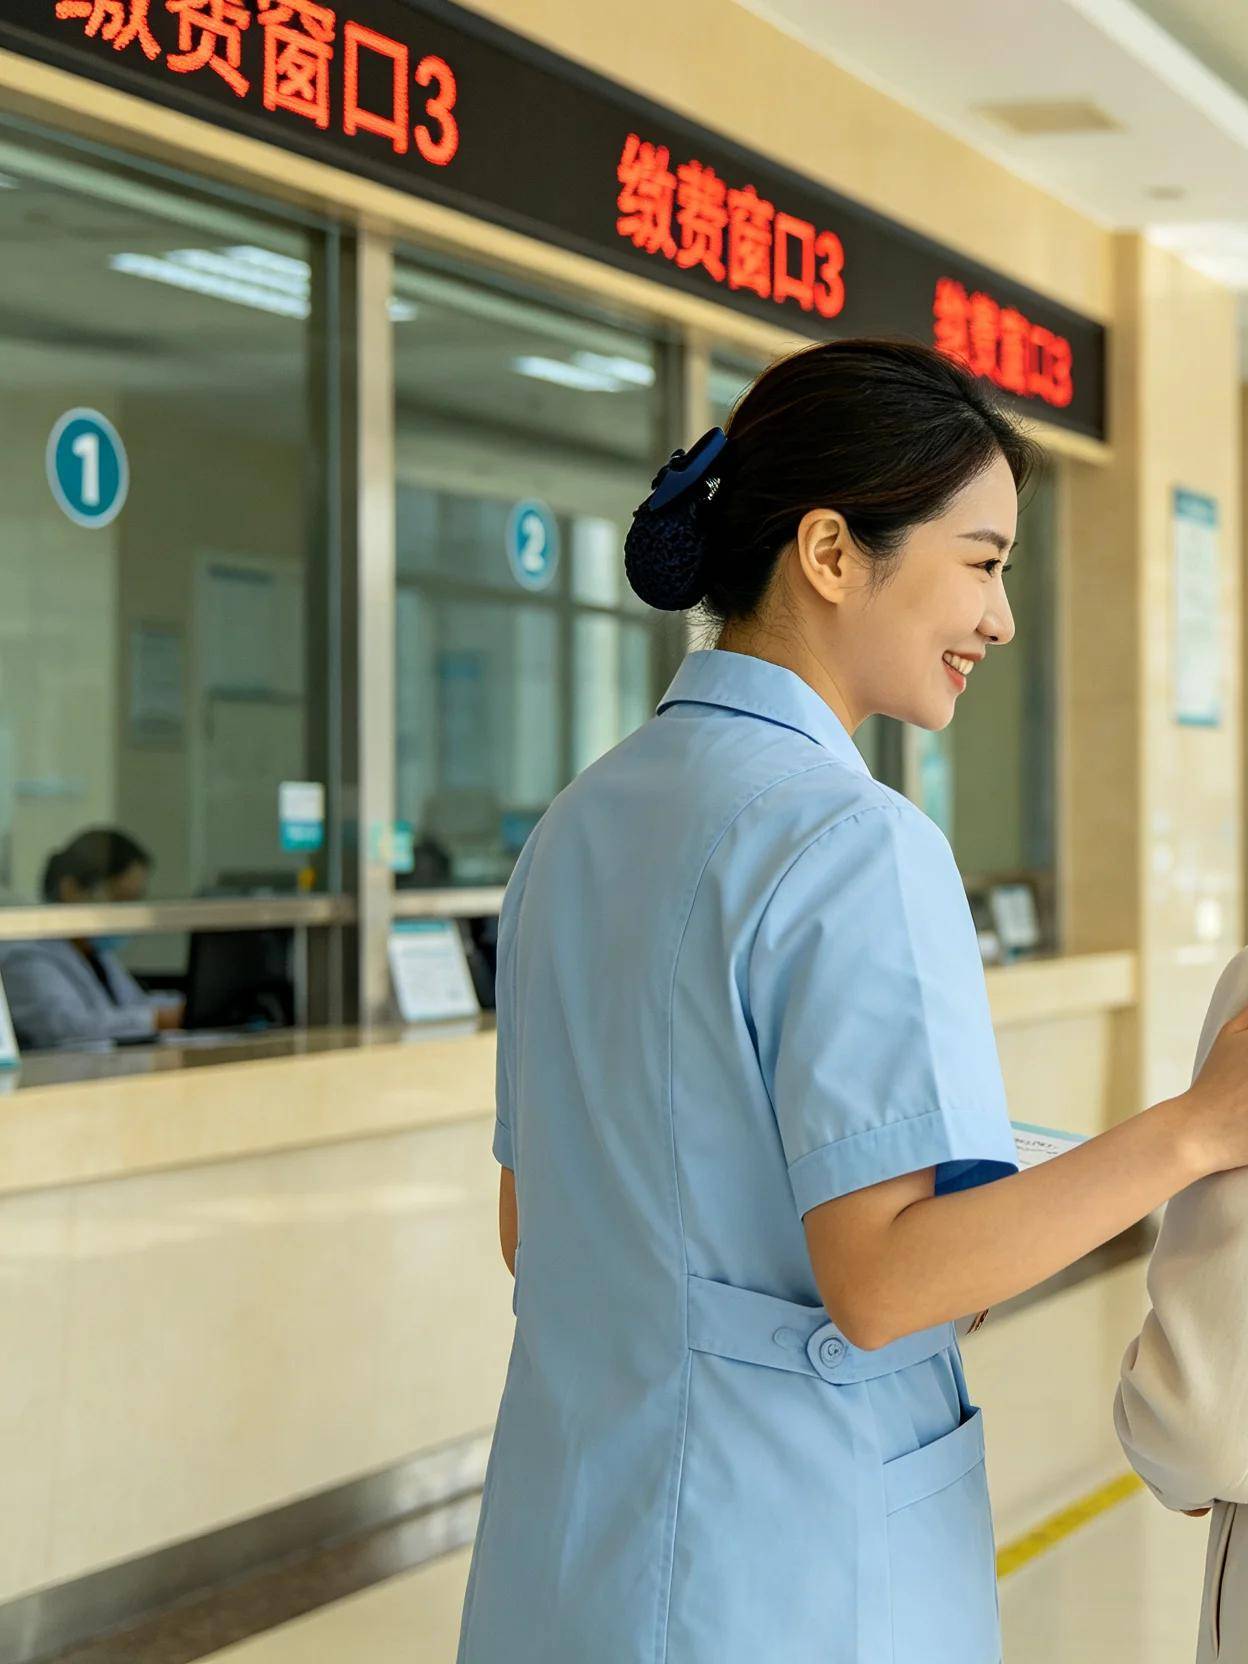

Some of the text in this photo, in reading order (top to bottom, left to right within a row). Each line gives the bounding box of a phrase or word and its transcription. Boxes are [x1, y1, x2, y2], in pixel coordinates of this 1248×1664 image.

[616, 132, 845, 318] 缴费窗口3
[72, 432, 100, 507] 1
[521, 514, 546, 572] 2
